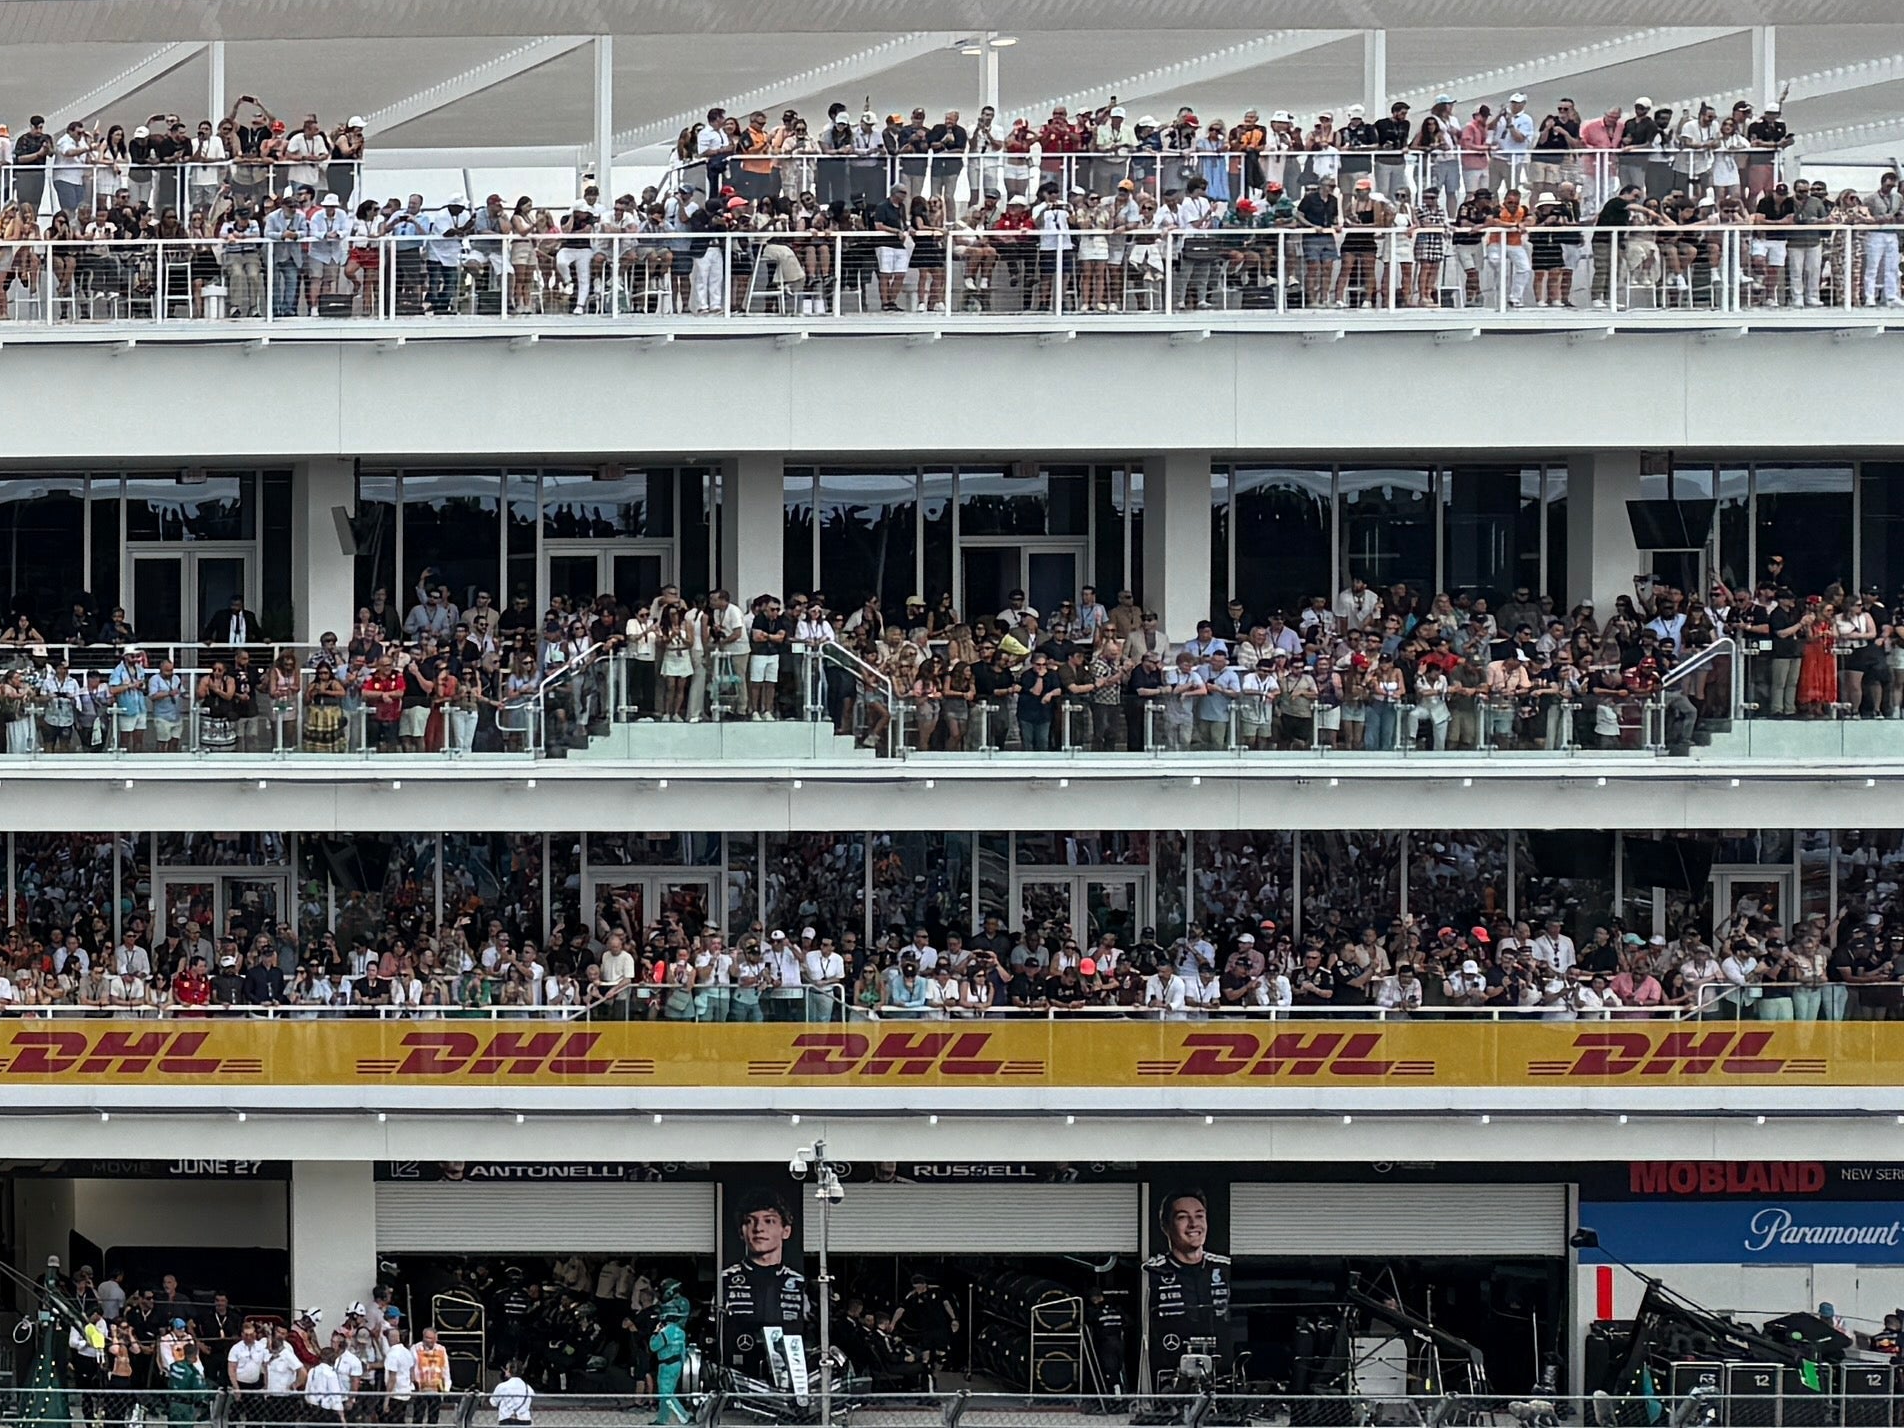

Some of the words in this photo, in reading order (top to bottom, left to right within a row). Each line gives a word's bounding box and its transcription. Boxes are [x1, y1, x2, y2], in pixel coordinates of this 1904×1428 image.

[8, 1032, 219, 1073] DHL
[398, 1032, 609, 1074] DHL
[794, 1033, 1000, 1075] DHL
[1180, 1033, 1390, 1075] DHL
[1572, 1032, 1779, 1075] DHL
[169, 1159, 230, 1175] JUNE
[233, 1159, 262, 1175] 27
[469, 1165, 624, 1177] ANTONELLI
[913, 1164, 1037, 1177] RUSSELL
[1629, 1162, 1827, 1193] MOBLAND
[1841, 1168, 1873, 1181] NEW
[1744, 1207, 1904, 1251] Paramount
[1754, 1374, 1770, 1387] 12
[1866, 1374, 1882, 1386] 12
